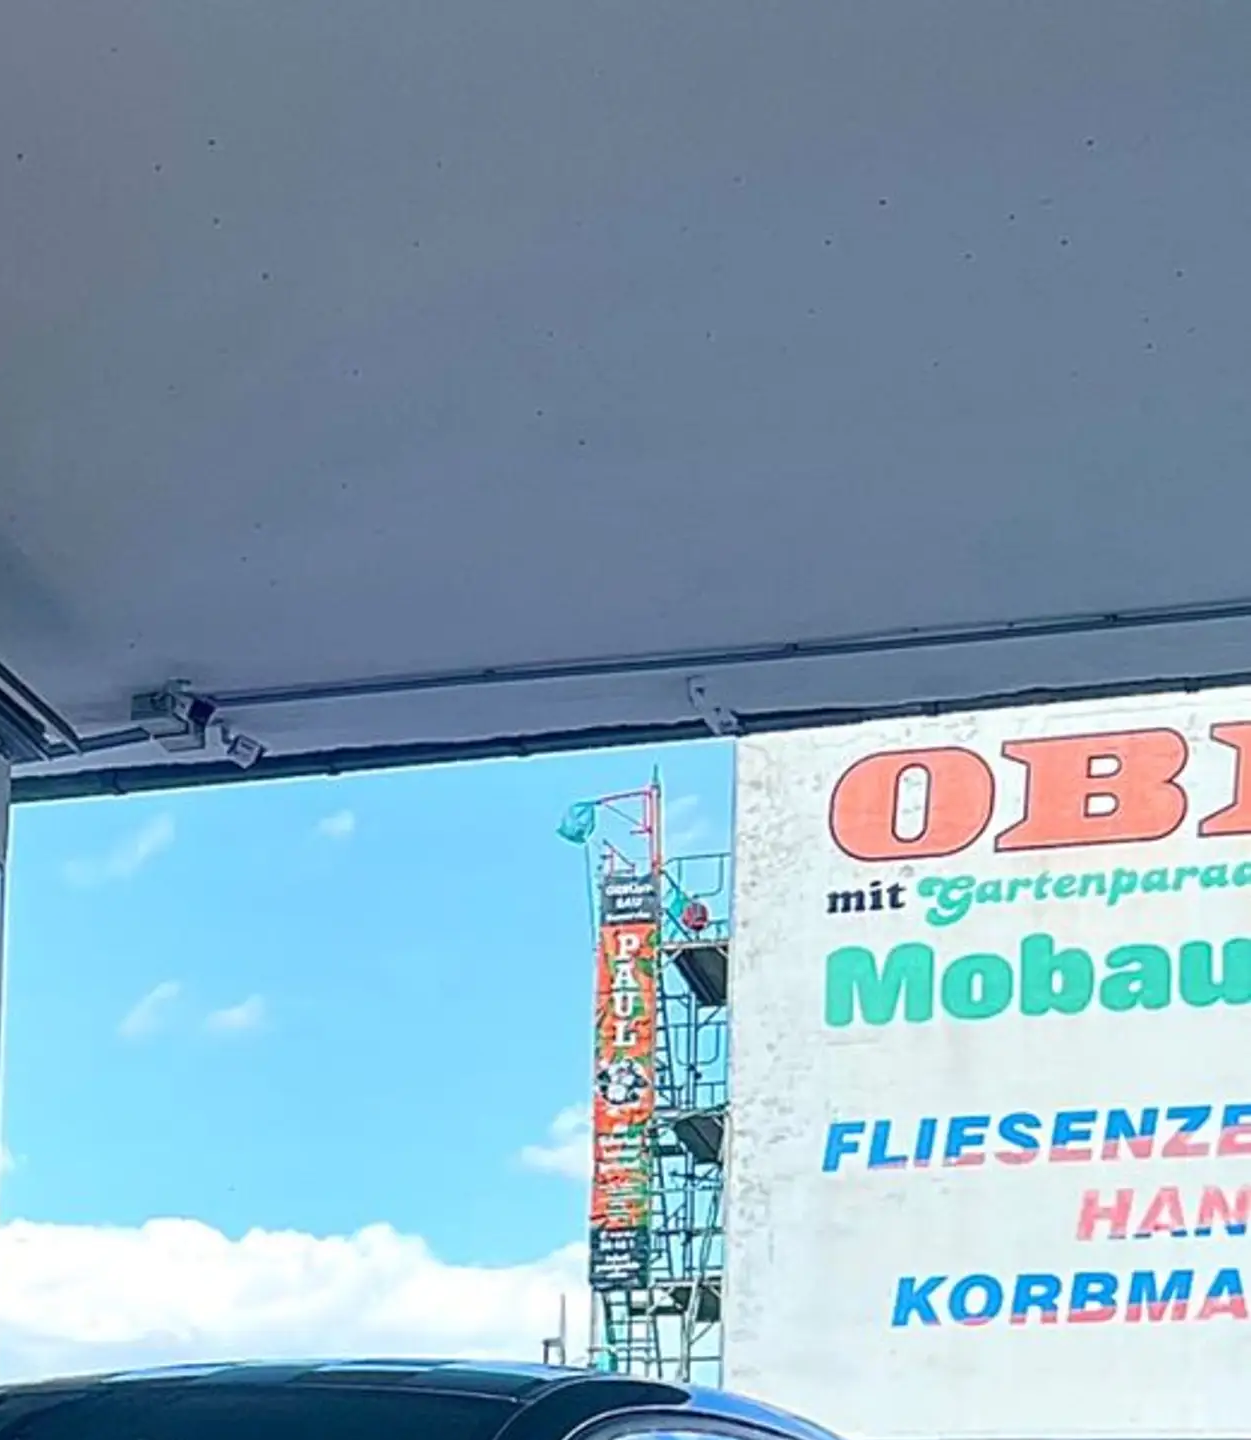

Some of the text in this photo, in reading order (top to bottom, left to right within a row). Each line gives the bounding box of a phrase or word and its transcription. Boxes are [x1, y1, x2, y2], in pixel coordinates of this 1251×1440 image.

[827, 879, 906, 914] mit
[611, 932, 641, 1048] PAUL
[824, 933, 1251, 1028] Mobau
[821, 1103, 1251, 1173] FLIESENZE
[1076, 1185, 1251, 1241] HAN
[891, 1267, 1248, 1328] KORBMA
